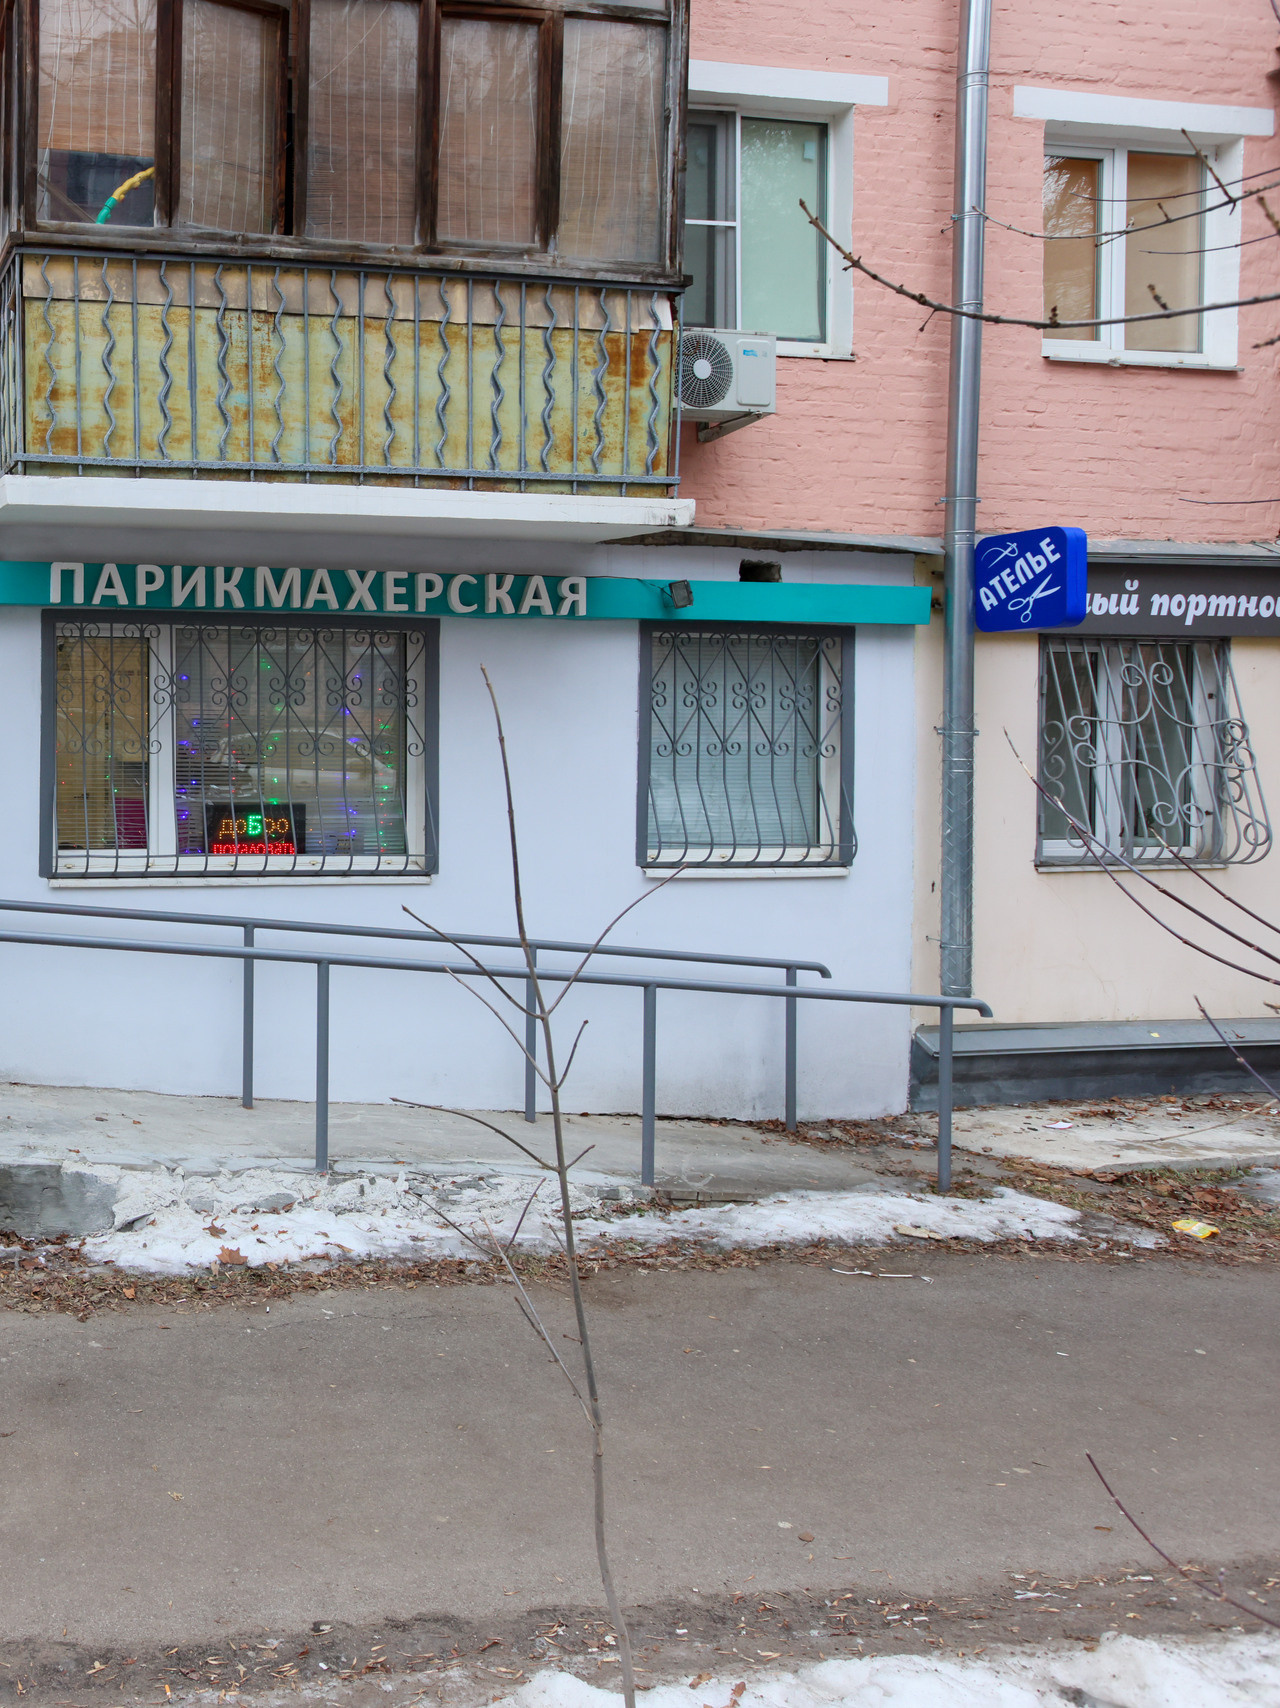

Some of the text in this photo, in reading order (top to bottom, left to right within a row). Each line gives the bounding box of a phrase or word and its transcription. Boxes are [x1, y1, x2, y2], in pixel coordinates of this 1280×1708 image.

[49, 562, 588, 616] ПАРИКМАХЕРСКАЯ
[979, 537, 1062, 612] АТЕЛЬЕ
[1150, 593, 1280, 626] портно
